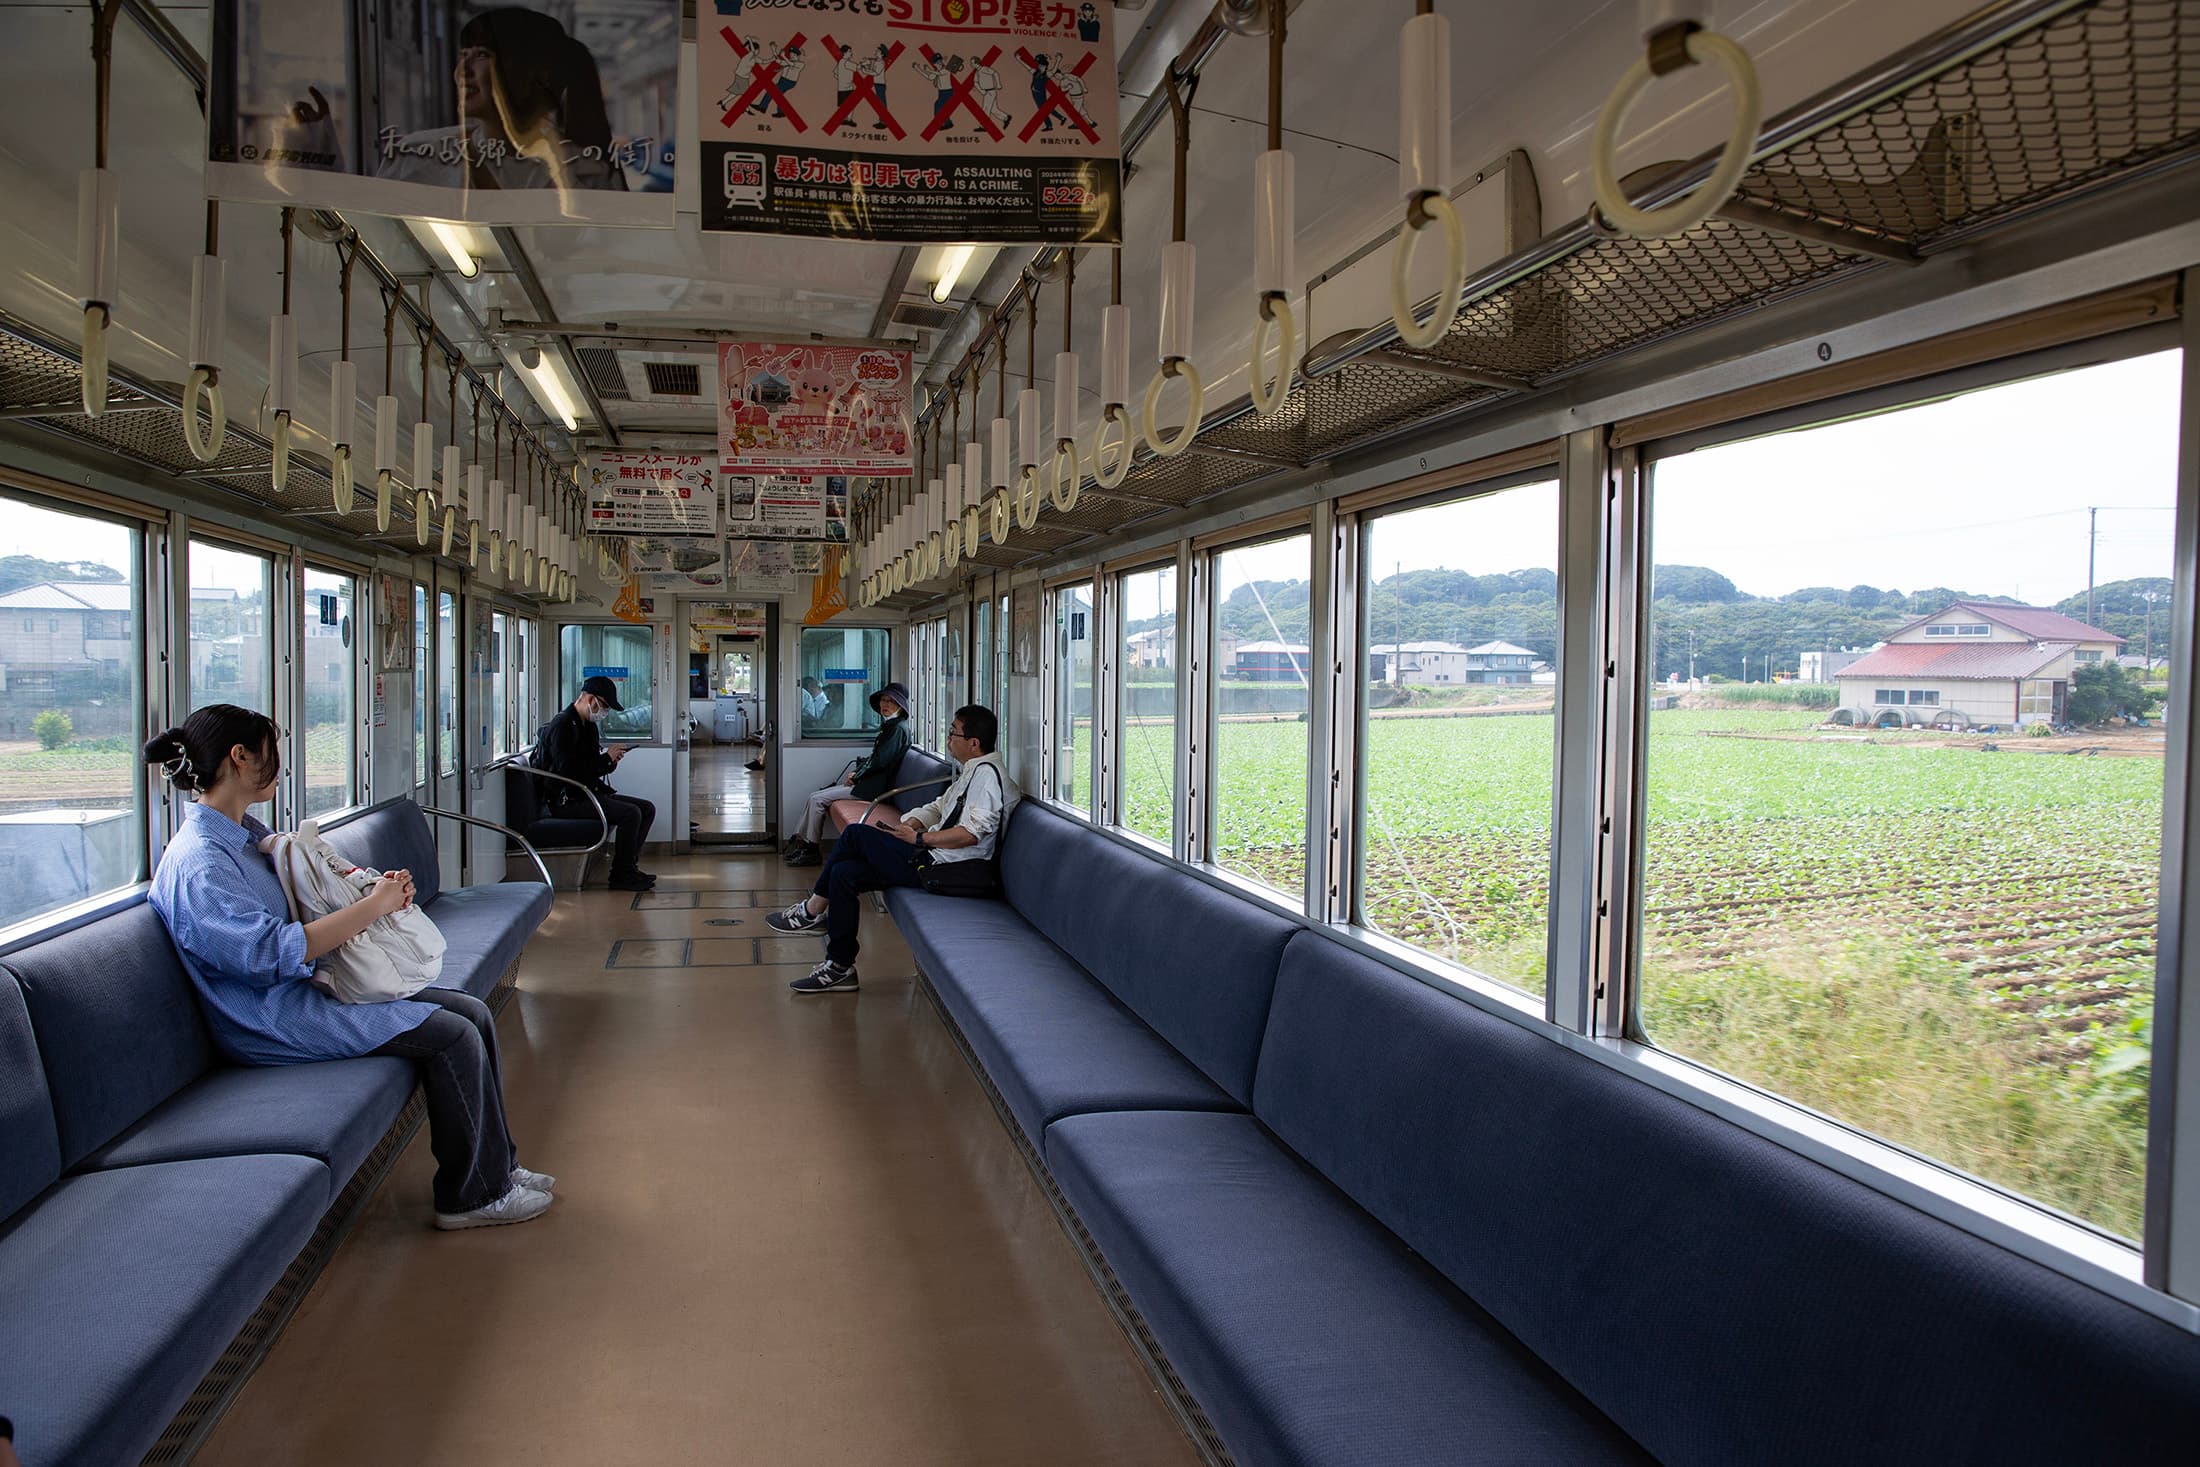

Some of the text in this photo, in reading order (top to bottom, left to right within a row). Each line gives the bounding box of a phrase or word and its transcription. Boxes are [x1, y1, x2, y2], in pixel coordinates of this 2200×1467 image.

[1012, 0, 1077, 29] 暴力
[1013, 29, 1059, 37] VIOLENCE
[730, 162, 760, 171] STOP
[774, 156, 948, 188] 暴力は犯罪です。
[954, 167, 1033, 179] ASSAULTING
[730, 171, 760, 186] 暴力
[954, 180, 1024, 191] IS A CRIME.
[601, 453, 702, 466] ニュースメールが
[619, 466, 683, 480] 無料で届く
